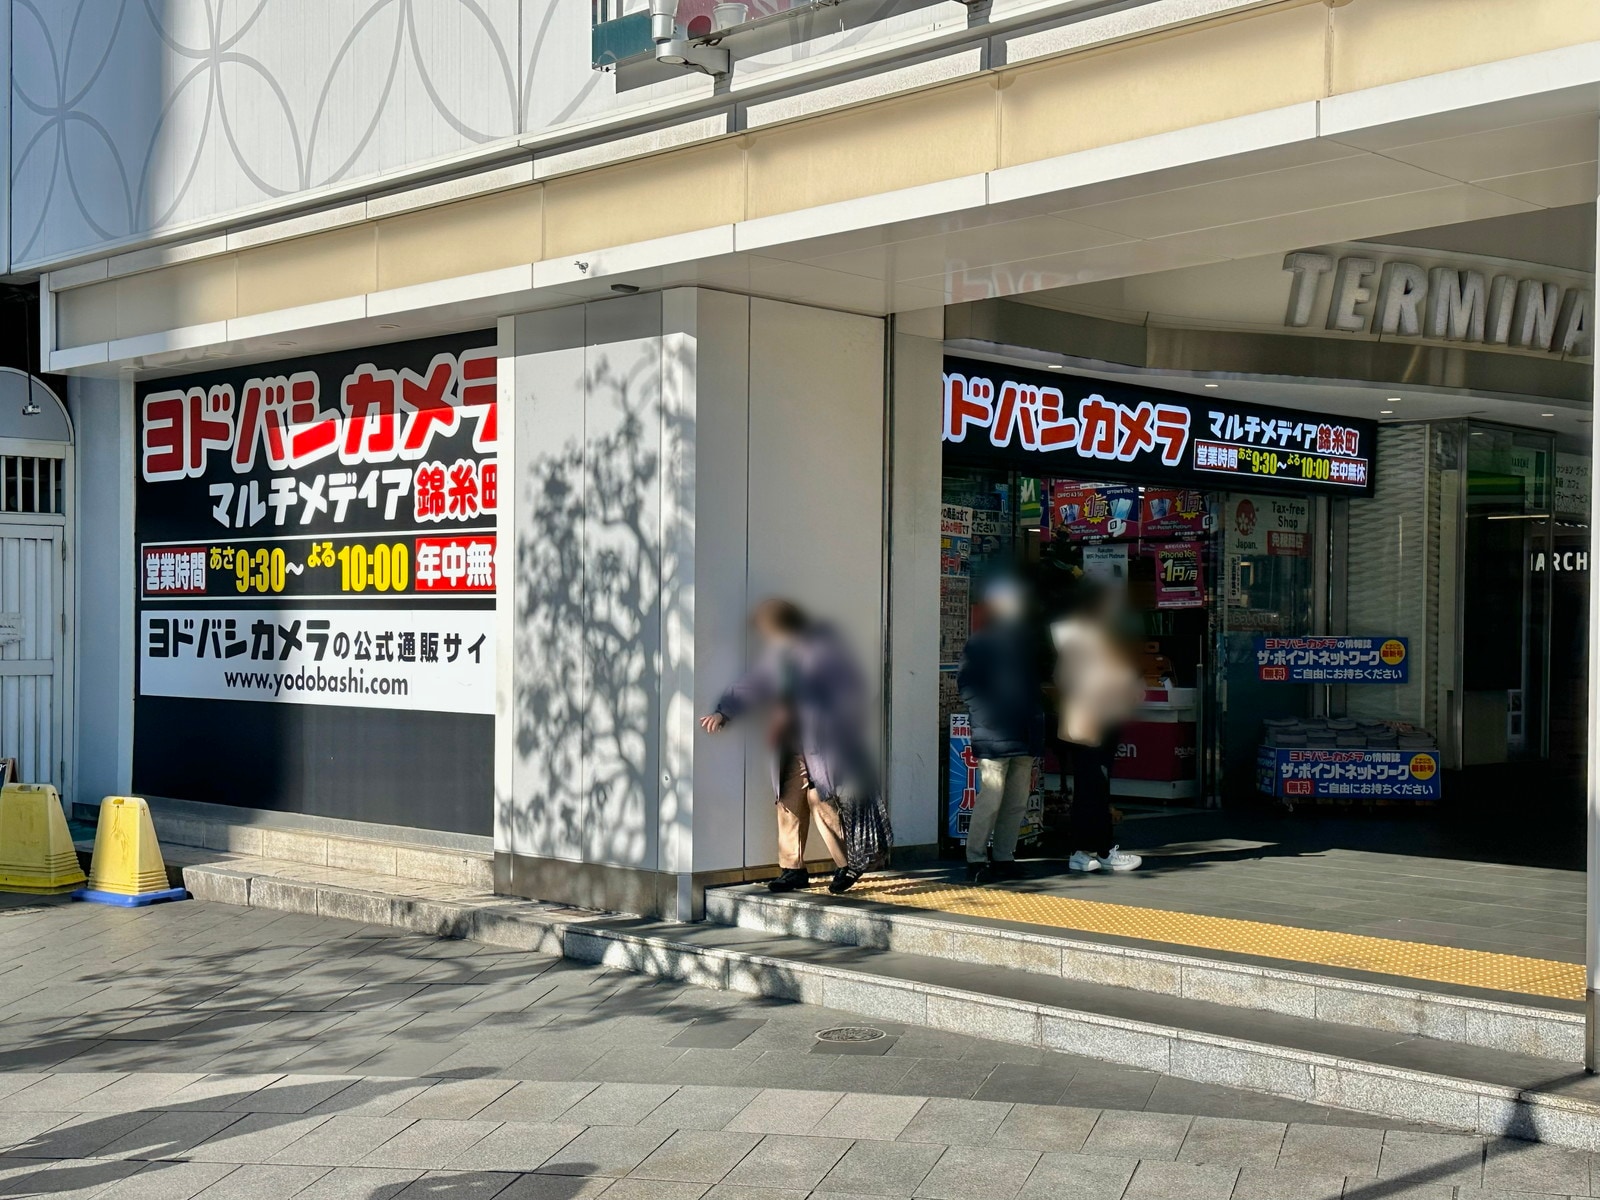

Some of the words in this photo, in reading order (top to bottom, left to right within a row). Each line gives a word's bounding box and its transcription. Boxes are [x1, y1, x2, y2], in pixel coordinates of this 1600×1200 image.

[1282, 252, 1593, 356] TERMINA
[143, 346, 497, 482] ヨドバシカメラ
[942, 372, 1190, 466] ドバシカメラ
[1197, 445, 1238, 469] 営業時間
[1330, 460, 1366, 482] 年中無休
[1272, 501, 1305, 515] Tax-free
[1278, 515, 1298, 530] Shop
[1158, 550, 1184, 559] iPhone
[146, 552, 206, 591] 営業時間
[417, 541, 497, 587] 年中無
[1262, 667, 1286, 680] 無料
[1293, 668, 1403, 680] ご自由にお持ちください
[224, 667, 409, 697] www.yodobashi.com
[1286, 781, 1312, 794] 無料
[1318, 783, 1433, 795] ご自由にお持ちください
